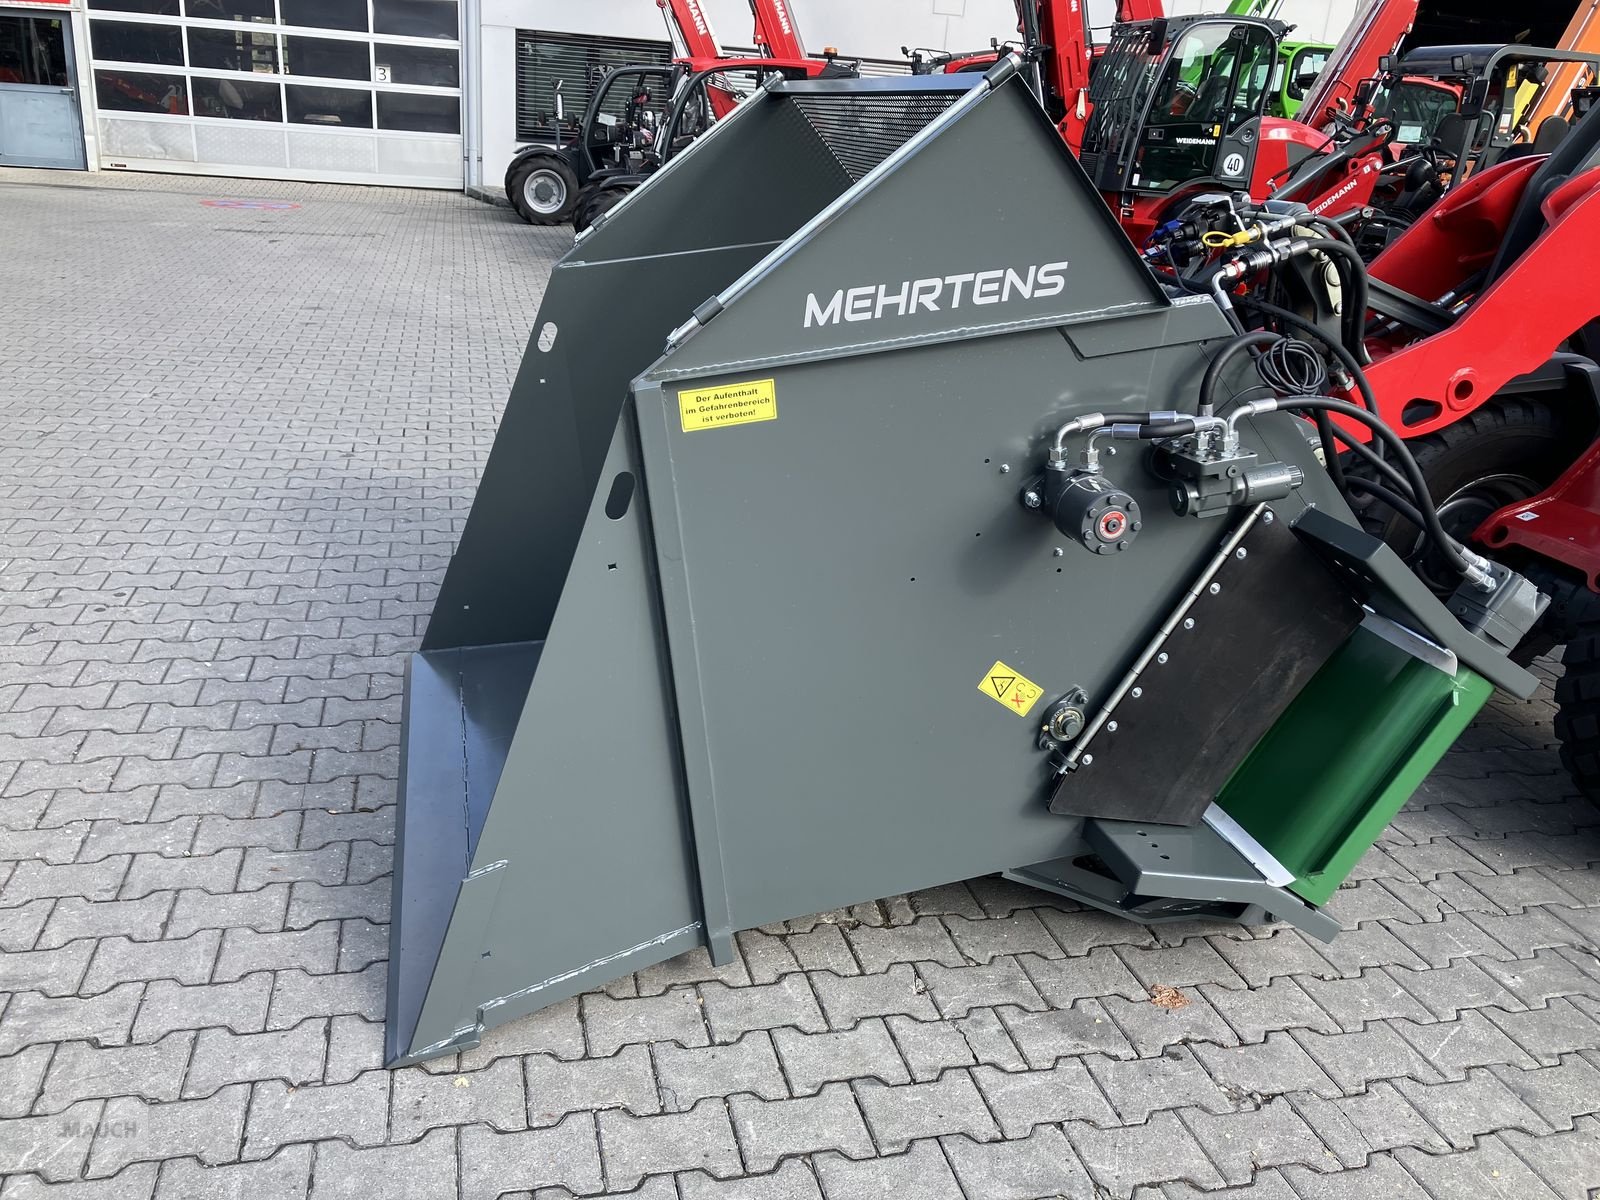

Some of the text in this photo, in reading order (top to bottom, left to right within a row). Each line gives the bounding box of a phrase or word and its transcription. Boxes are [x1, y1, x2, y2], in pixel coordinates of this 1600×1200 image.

[378, 67, 387, 81] 3
[1175, 137, 1216, 146] WEIDEMANN
[1227, 157, 1241, 172] 40
[803, 261, 1069, 328] MEHRTENS
[695, 388, 758, 403] Der Aufenthalt
[685, 397, 770, 415] im Gefahrenbereich
[702, 409, 756, 423] ist verboten!
